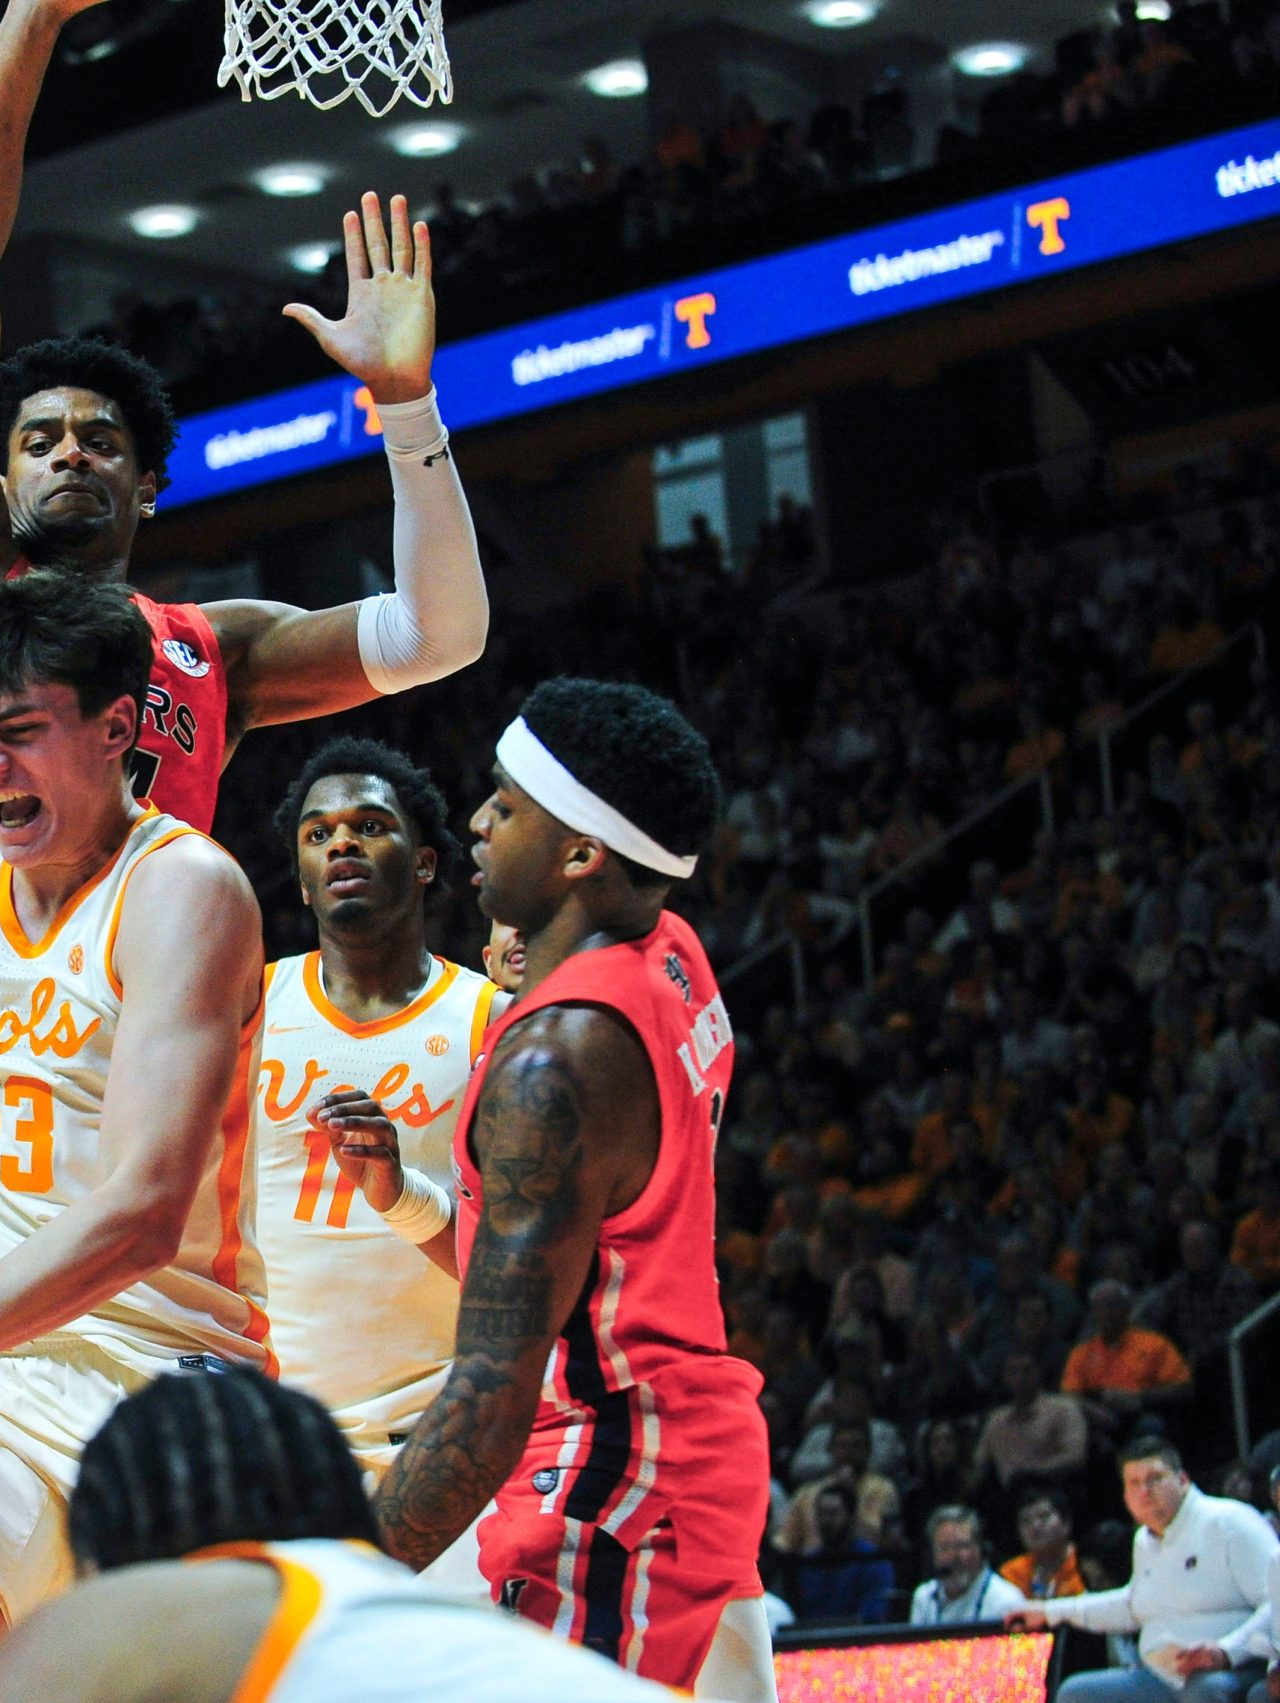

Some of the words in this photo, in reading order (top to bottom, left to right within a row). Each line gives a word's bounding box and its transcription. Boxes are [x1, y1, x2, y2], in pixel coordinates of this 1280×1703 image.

[1027, 197, 1070, 255] T
[675, 293, 716, 349] T
[258, 1059, 454, 1128] Vls
